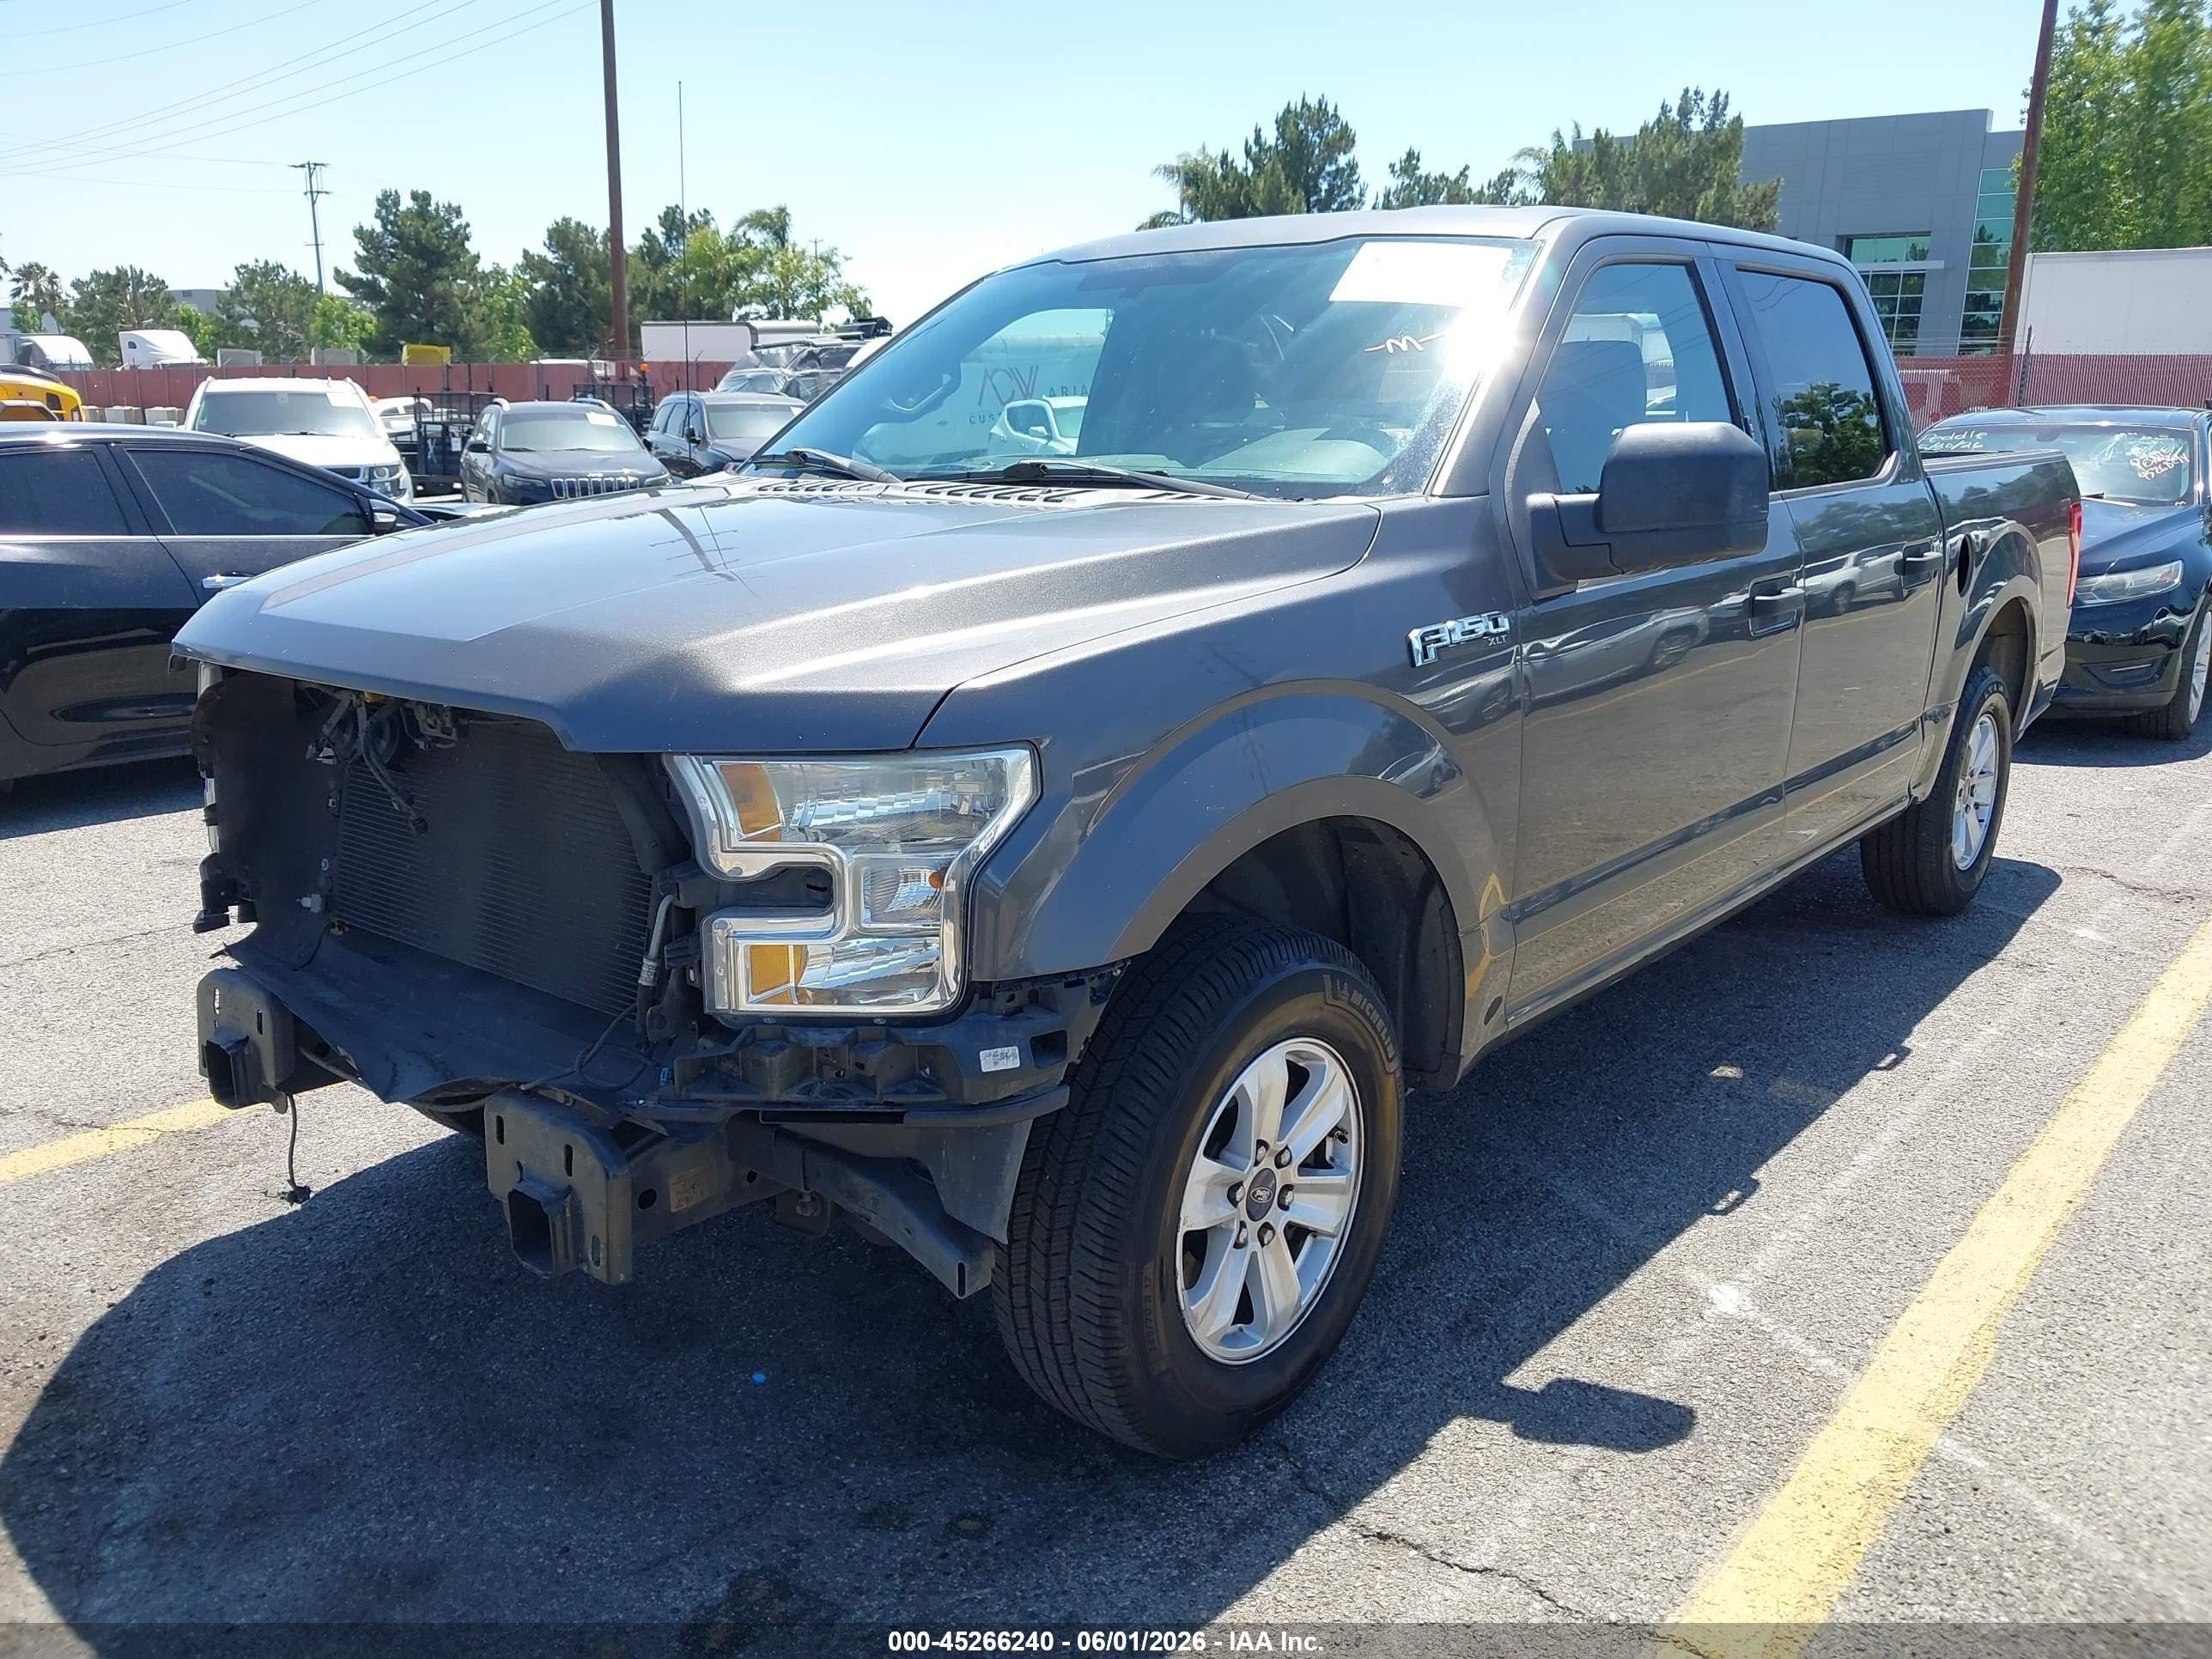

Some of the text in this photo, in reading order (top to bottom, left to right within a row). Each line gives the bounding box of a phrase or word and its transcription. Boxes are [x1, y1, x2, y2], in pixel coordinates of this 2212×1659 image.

[969, 412, 1002, 425] CUS
[1487, 635, 1507, 647] XLT
[1349, 988, 1395, 1059] MICHELIN
